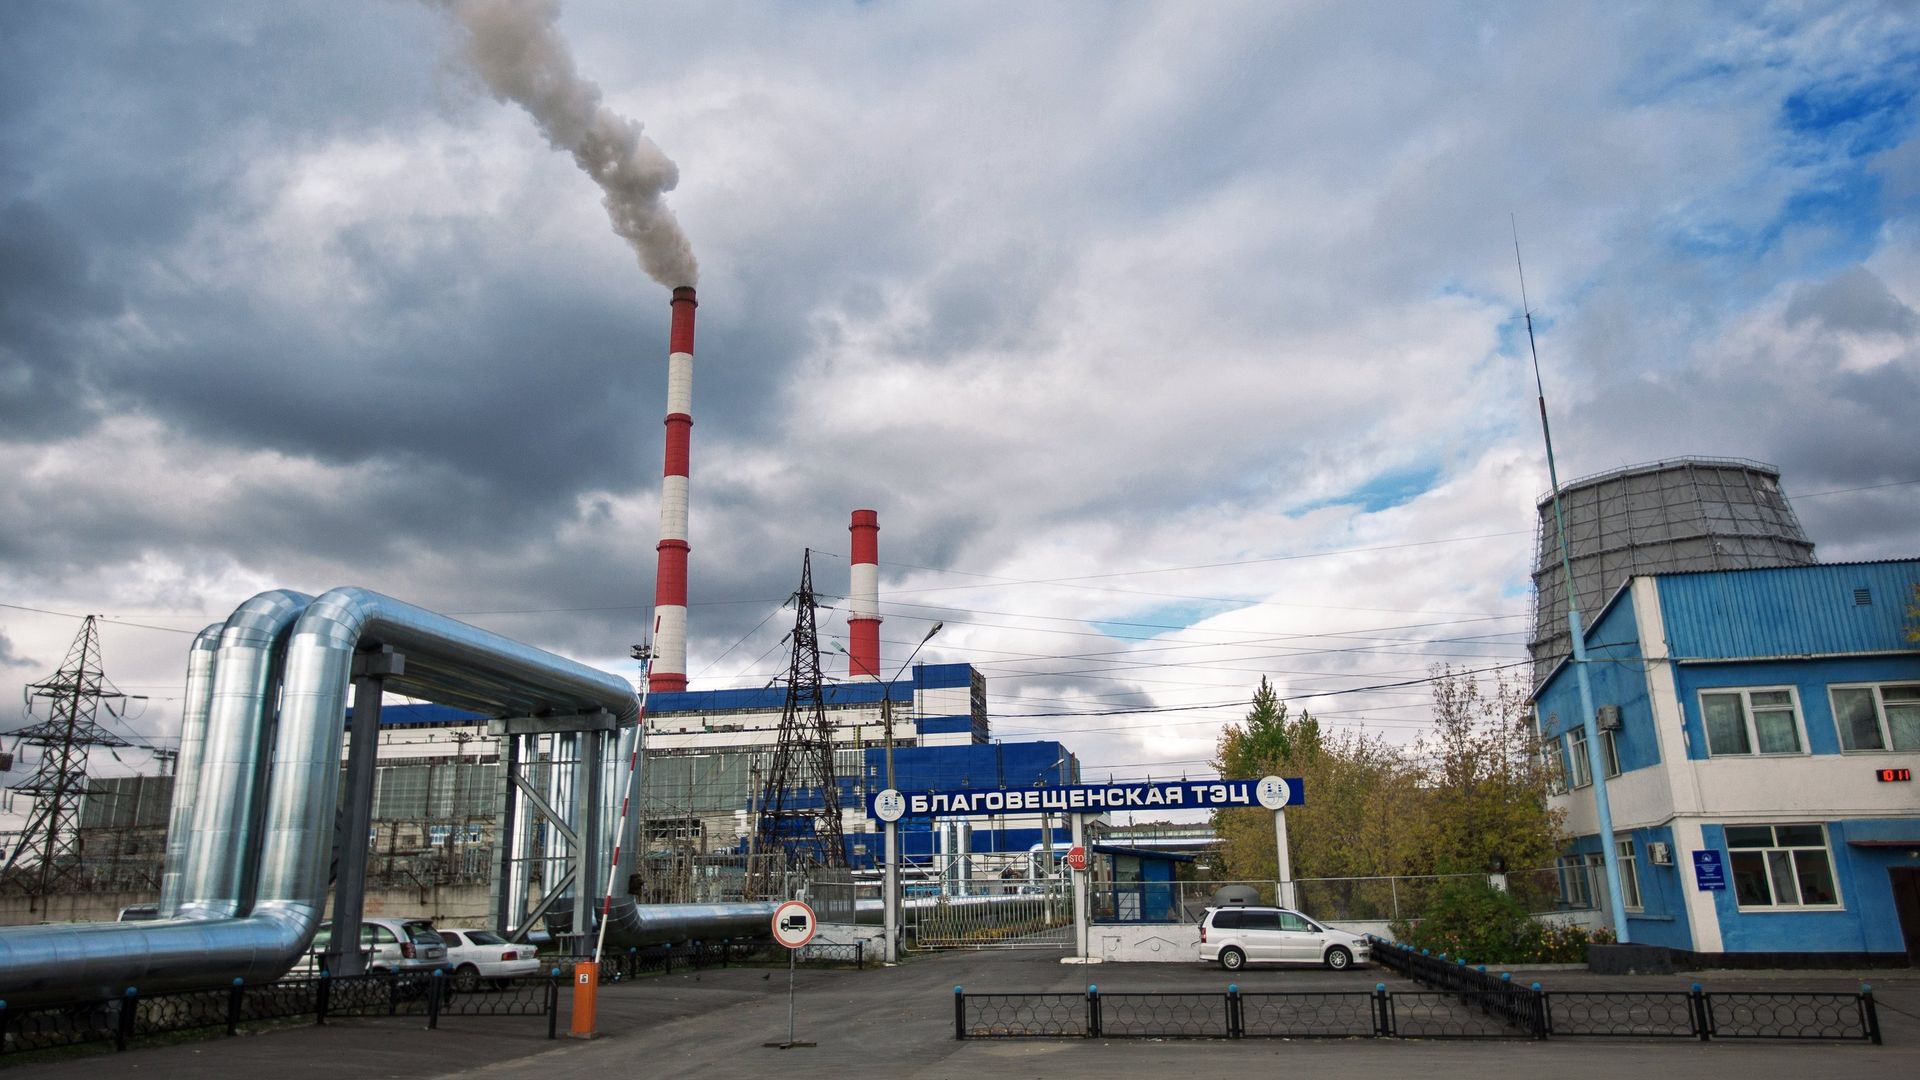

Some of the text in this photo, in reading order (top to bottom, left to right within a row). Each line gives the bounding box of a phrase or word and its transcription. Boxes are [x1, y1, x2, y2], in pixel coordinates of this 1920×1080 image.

[911, 784, 1250, 813] БЛАГОВЕЩЕНСКАЯ ТЭЦ
[1070, 854, 1084, 863] STO
